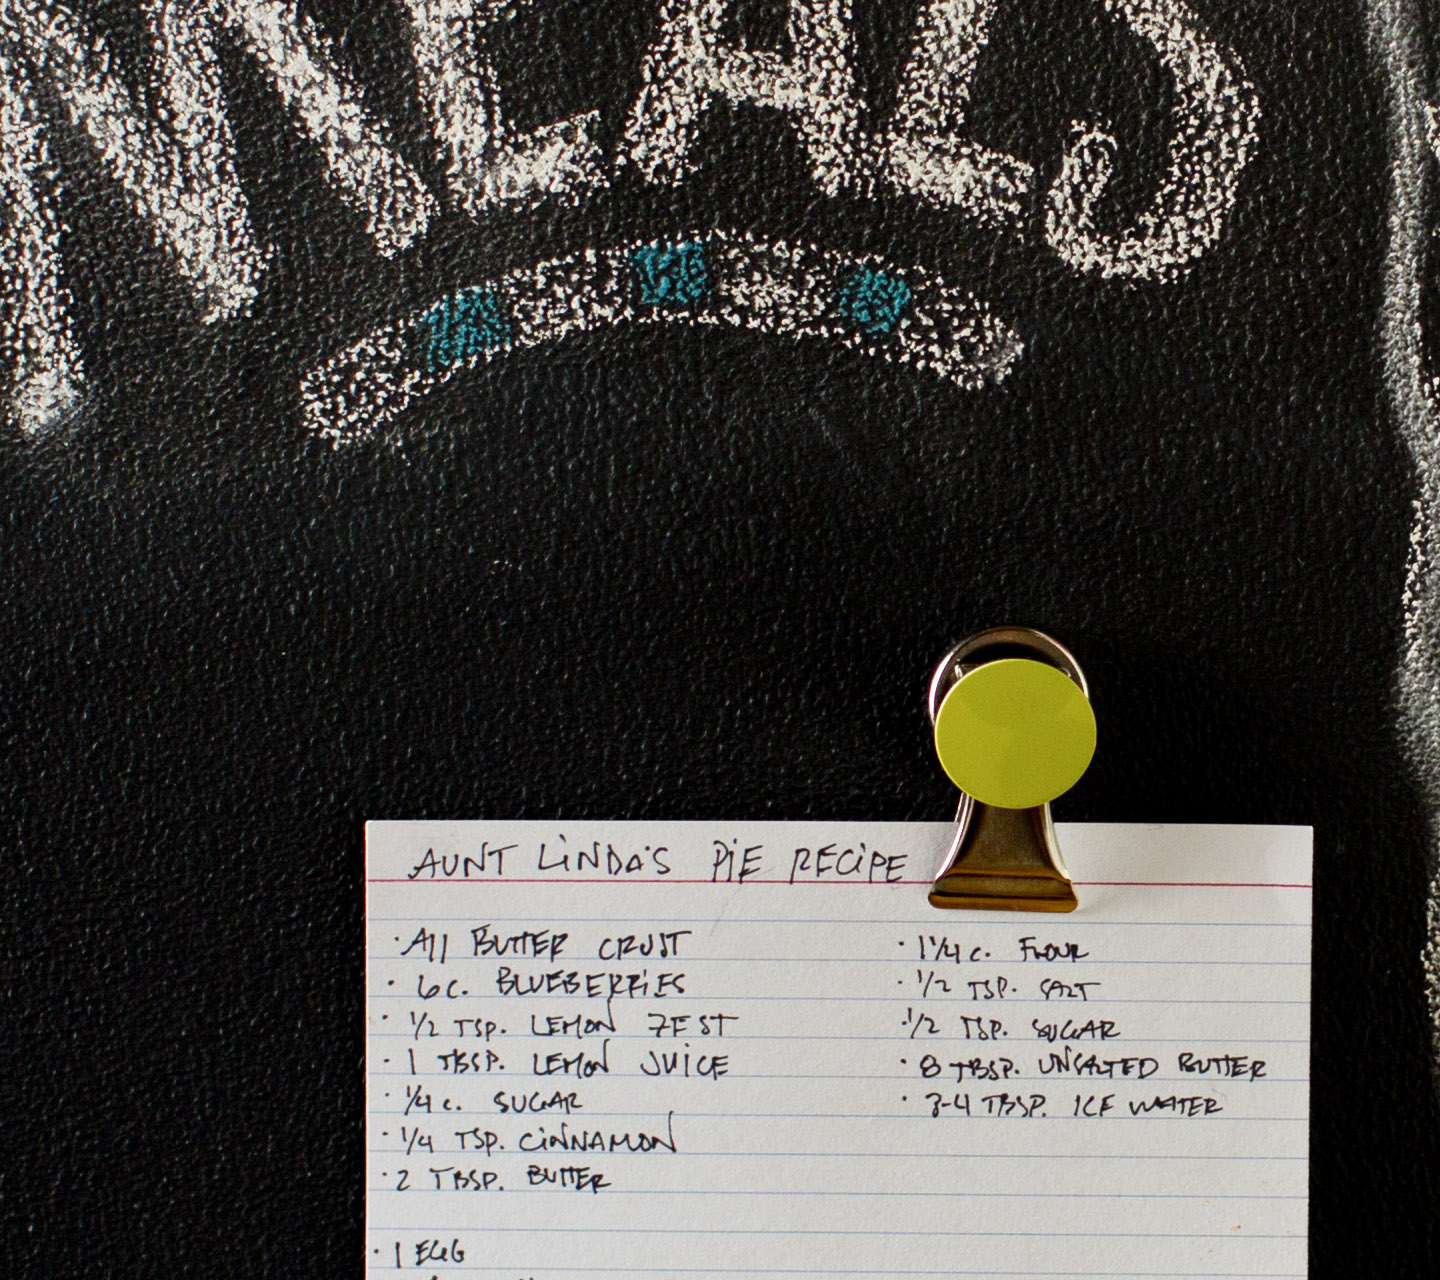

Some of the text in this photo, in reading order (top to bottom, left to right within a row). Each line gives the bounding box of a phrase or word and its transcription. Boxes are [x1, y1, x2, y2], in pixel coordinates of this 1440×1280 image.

[407, 842, 519, 880] AUNT
[712, 837, 763, 884] PIE
[788, 840, 906, 885] RECIPE
[471, 923, 568, 963] BUTTER
[598, 930, 692, 961] CRUST
[1019, 936, 1090, 964] FLOUR
[496, 966, 687, 1000] BLUEBERRIES
[917, 969, 1101, 1003] 1/2 TSP. SALT
[410, 1011, 439, 1041] 1/2
[530, 997, 617, 1039] LEMON
[647, 1012, 739, 1039] ZEST
[960, 1015, 1008, 1041] TSP.
[1031, 1018, 1121, 1043] SUGAR
[532, 1038, 611, 1077] LEMON
[639, 1042, 730, 1081] JUICE
[919, 1045, 1267, 1083] 8 TBSP. UNSALTED BUTTER
[403, 1084, 432, 1116] 1/4
[493, 1091, 584, 1115] SUGAR
[925, 1092, 1223, 1119] 3-4 TBSP. ICE WATER
[401, 1110, 678, 1157] 1/4 TSP. CINNAMON
[396, 1165, 612, 1194] 2 TBSP. BUTTER
[415, 1238, 466, 1266] EGG
